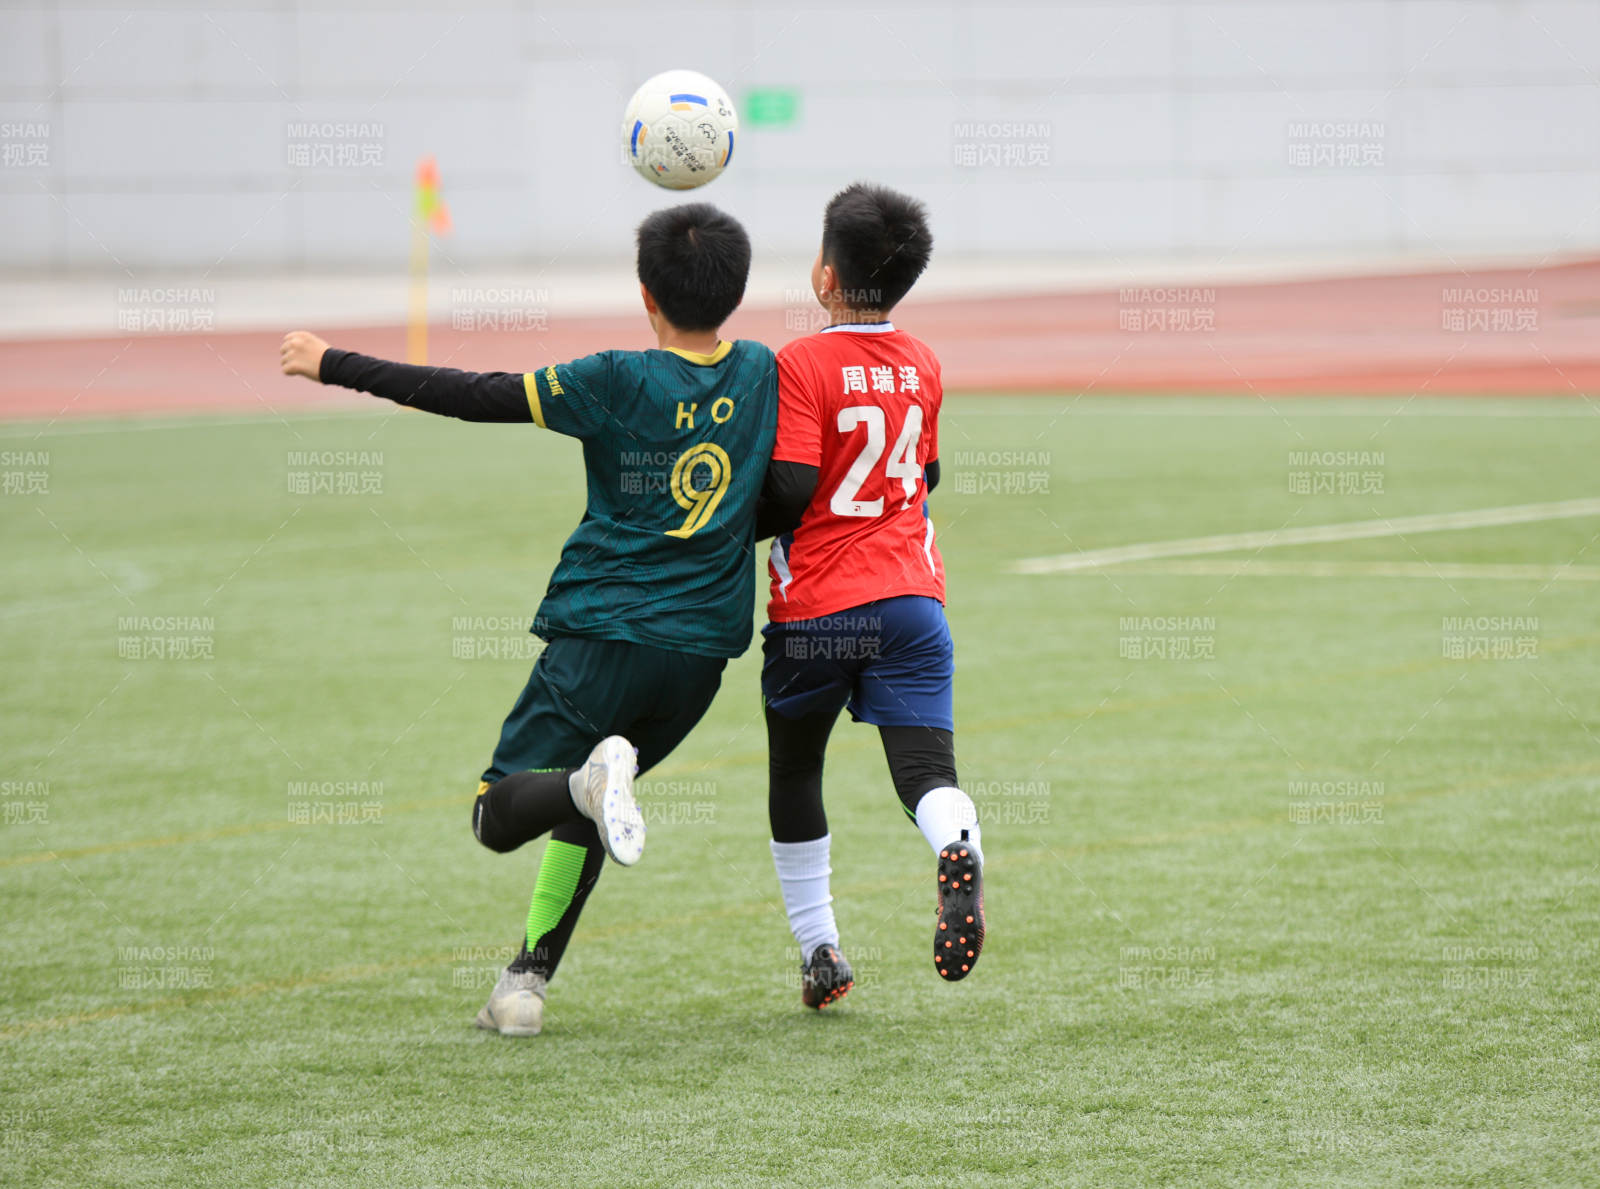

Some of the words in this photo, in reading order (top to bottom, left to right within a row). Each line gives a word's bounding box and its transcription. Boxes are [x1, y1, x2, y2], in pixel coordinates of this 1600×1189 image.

[842, 366, 920, 394] 周瑞泽
[663, 442, 731, 539] 9
[830, 404, 923, 517] 24
